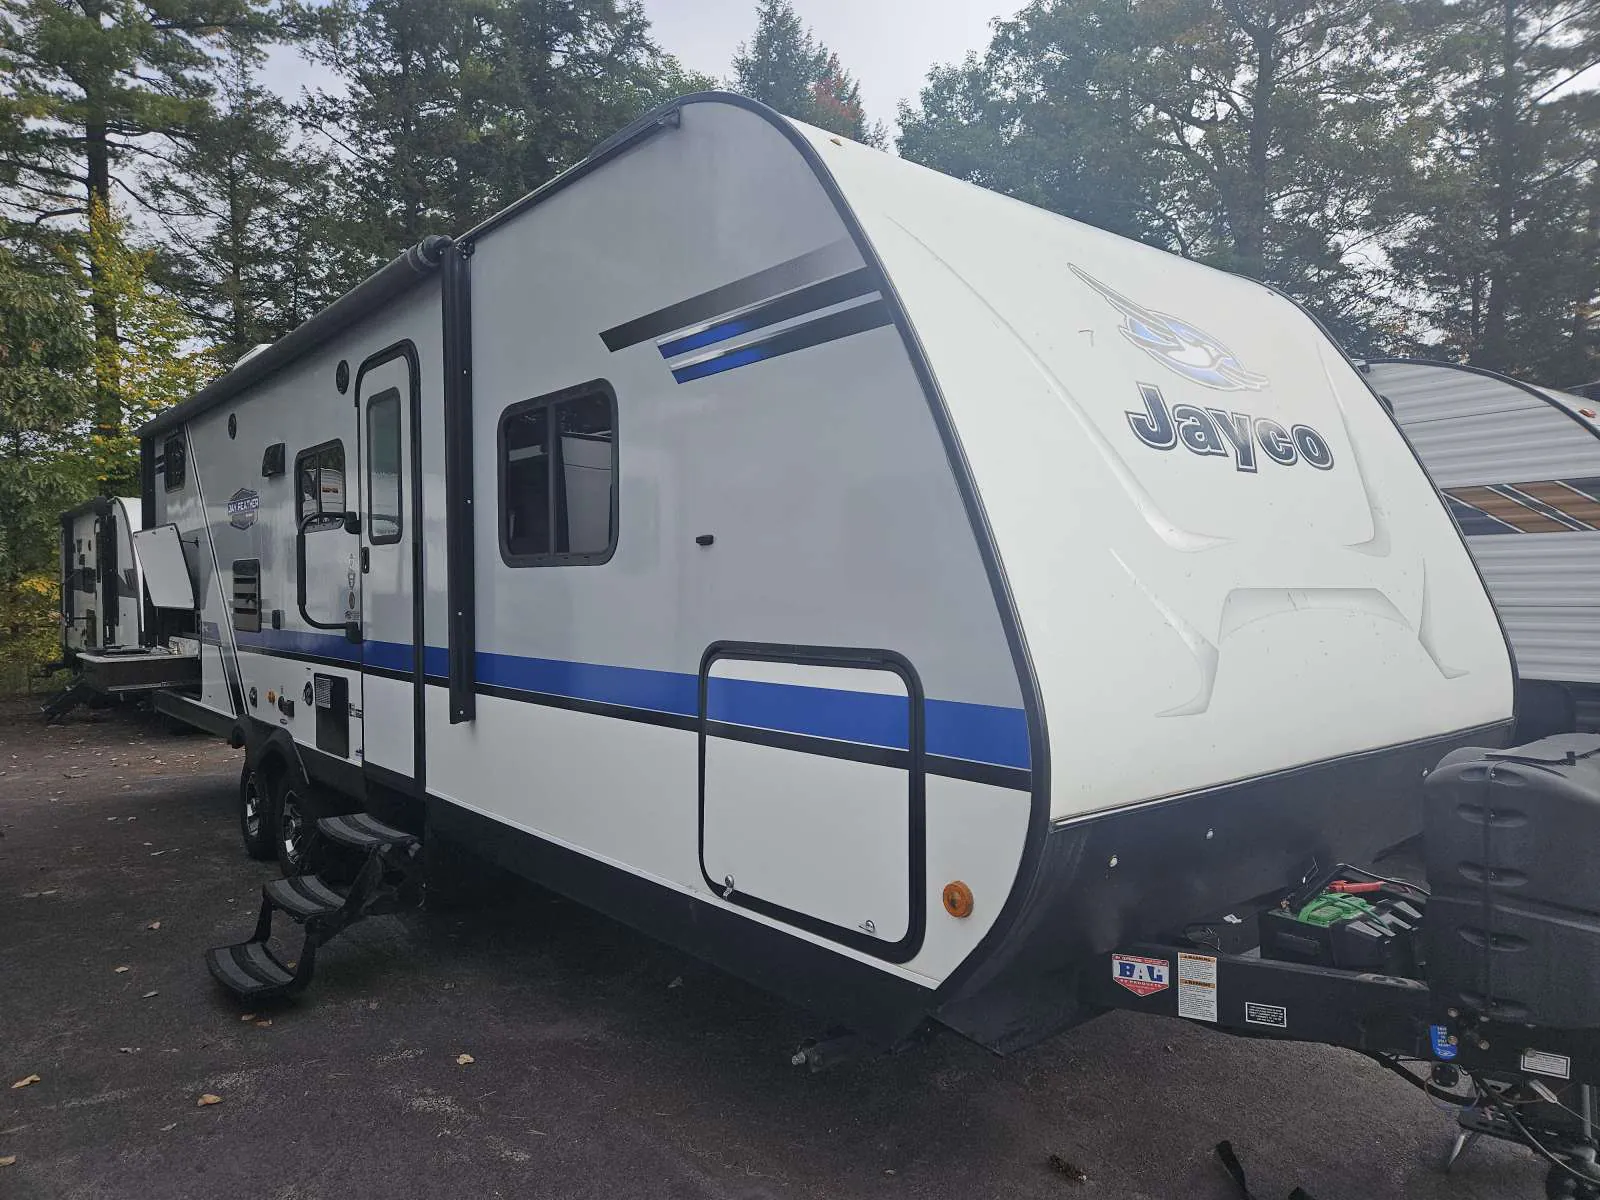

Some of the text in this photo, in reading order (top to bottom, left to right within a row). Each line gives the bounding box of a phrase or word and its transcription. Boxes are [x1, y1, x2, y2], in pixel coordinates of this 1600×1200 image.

[1124, 381, 1335, 473] Jayco
[228, 498, 259, 513] JAY FEATHER
[1118, 962, 1163, 982] BAL
